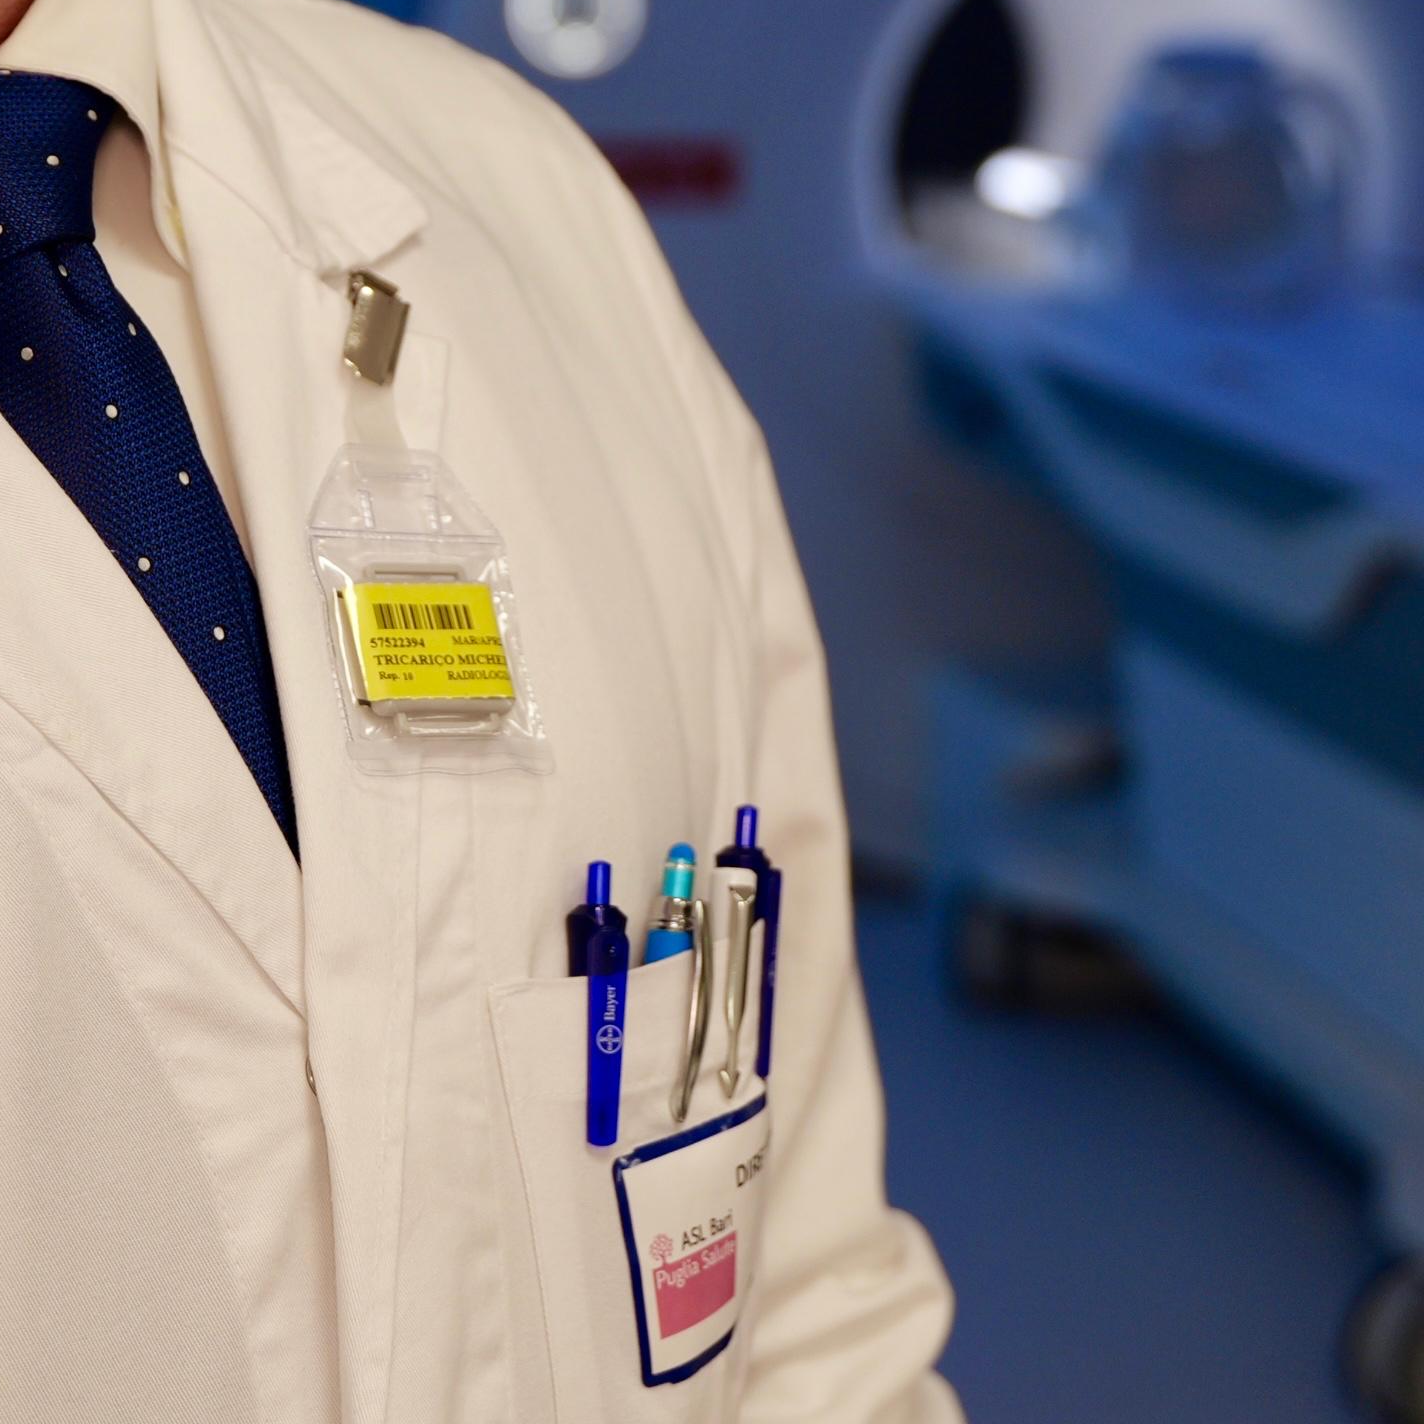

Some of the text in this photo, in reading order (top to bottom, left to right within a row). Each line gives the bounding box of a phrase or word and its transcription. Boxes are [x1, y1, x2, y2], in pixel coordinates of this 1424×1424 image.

[369, 636, 426, 649] 57522394
[604, 985, 619, 1021] Bayer
[681, 1208, 733, 1251] ASL Bari
[656, 1236, 736, 1290] Puglia Salute
